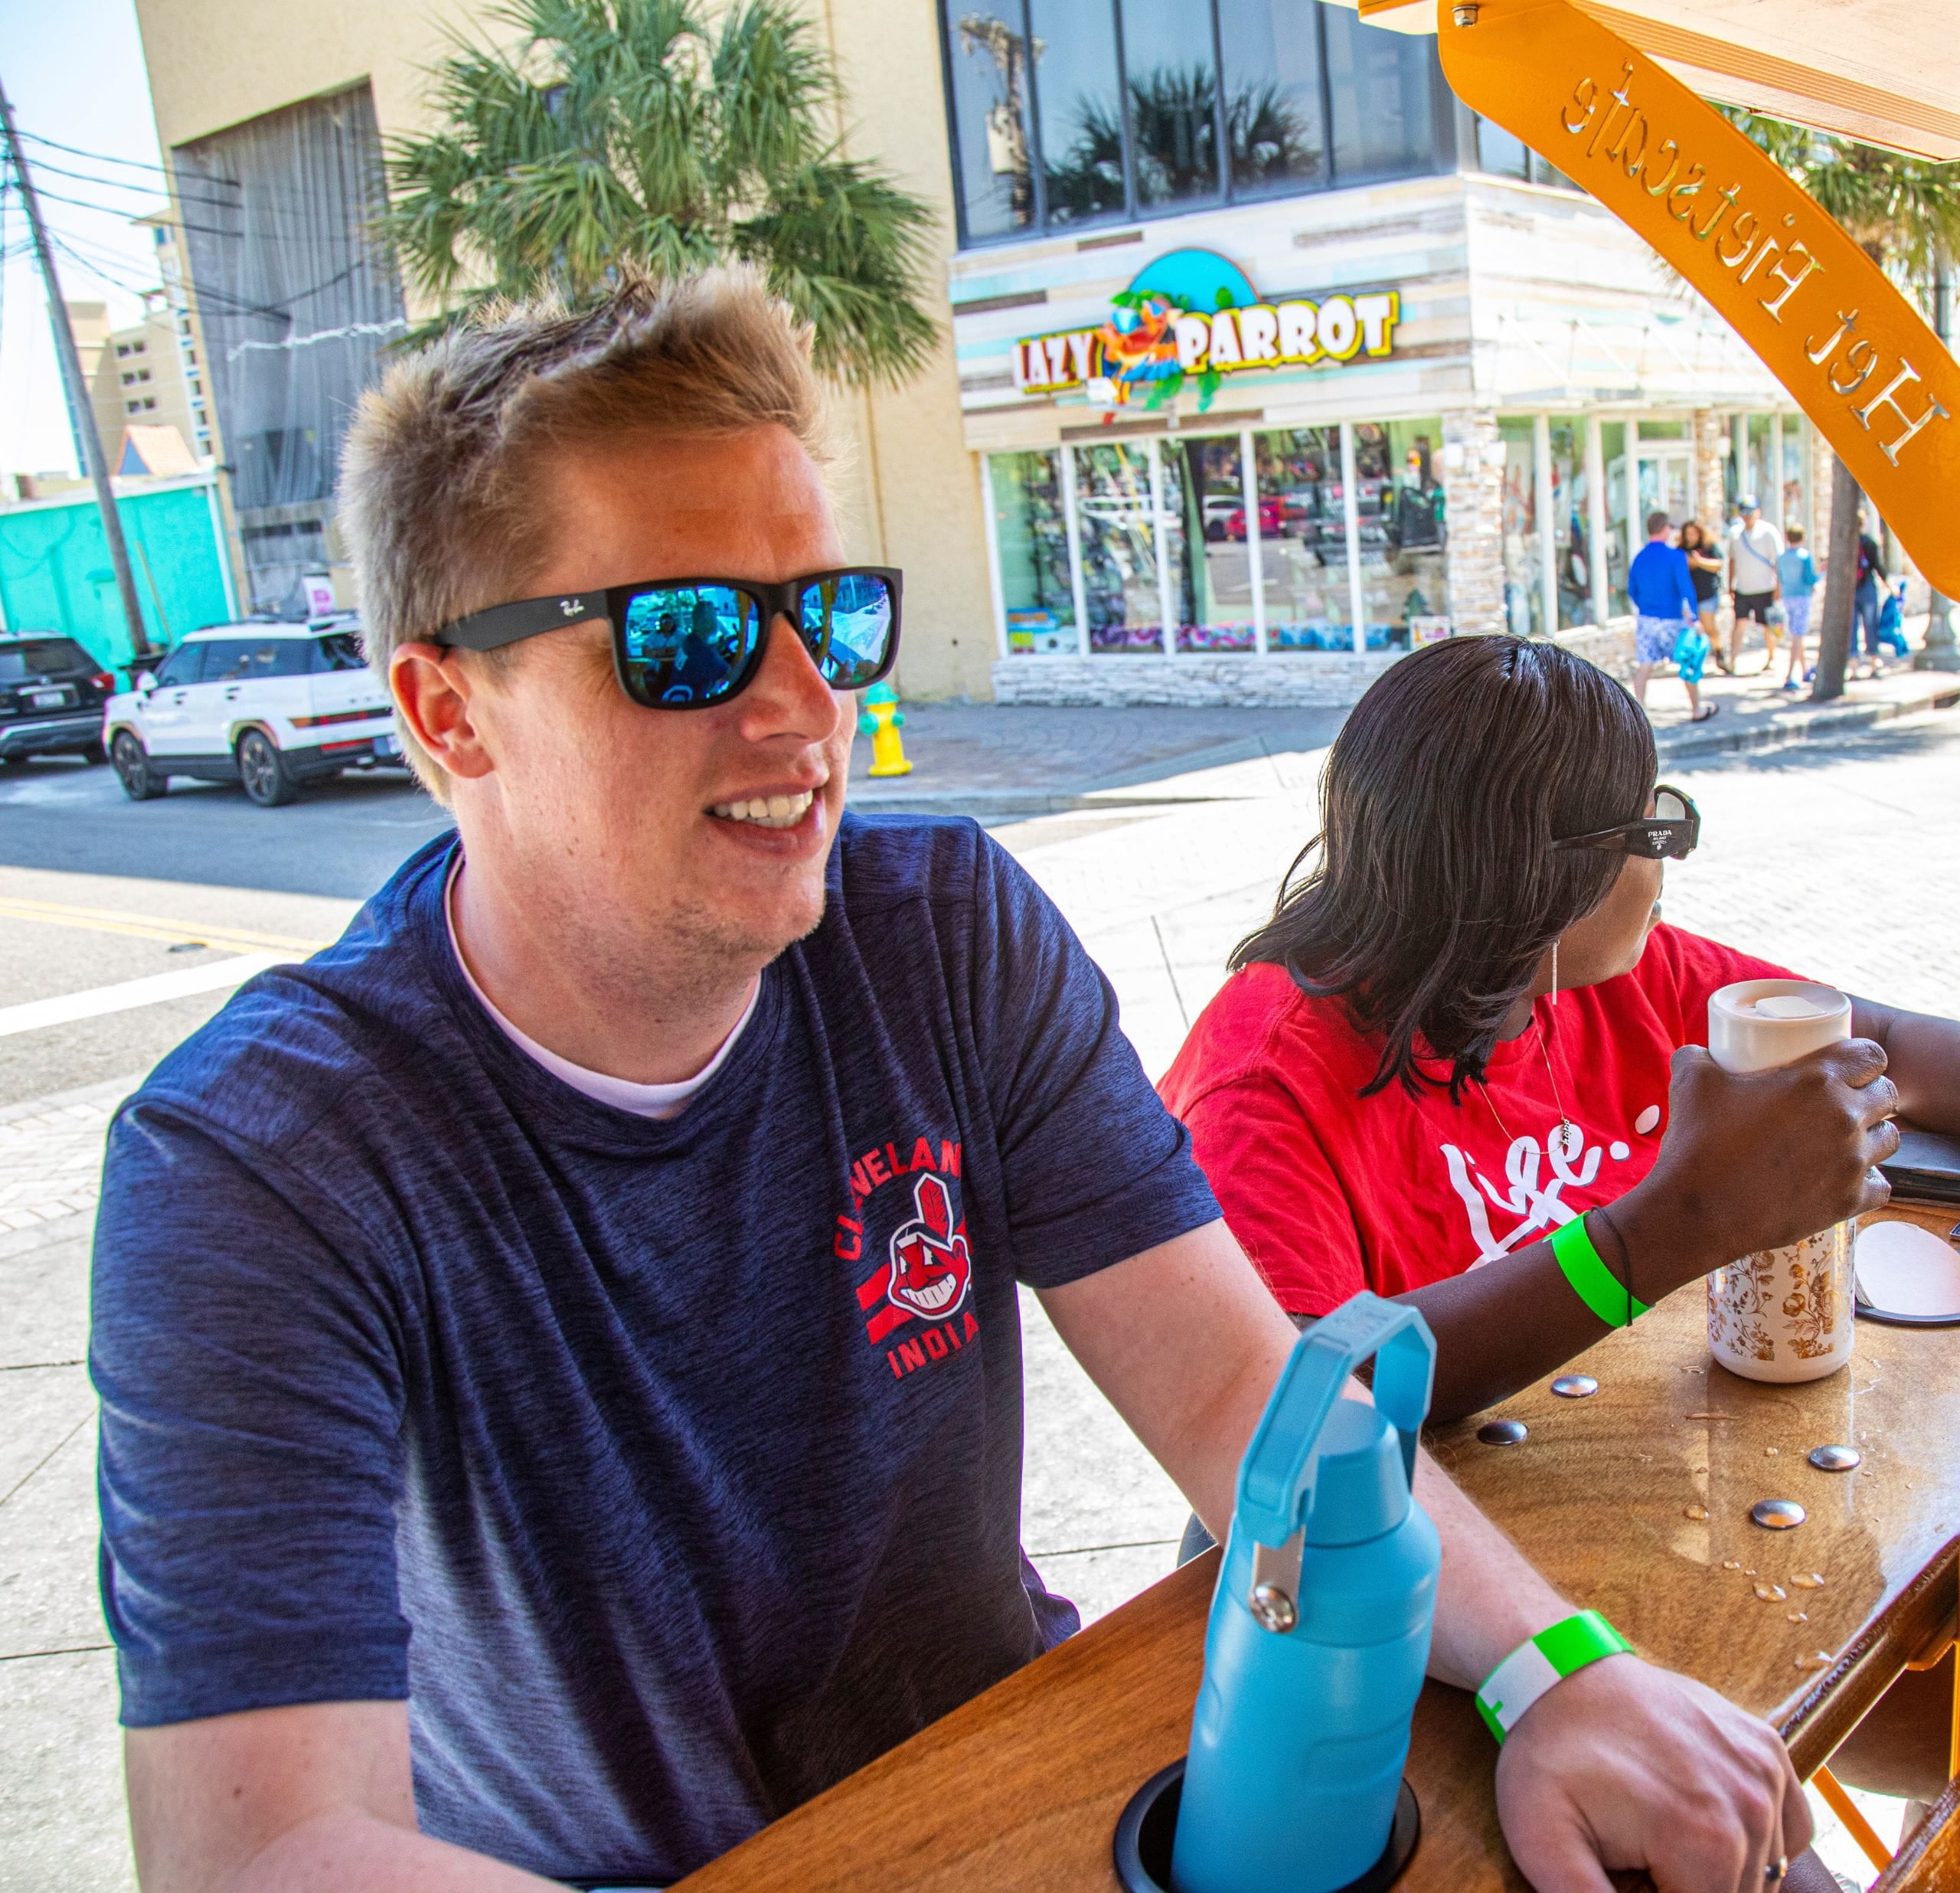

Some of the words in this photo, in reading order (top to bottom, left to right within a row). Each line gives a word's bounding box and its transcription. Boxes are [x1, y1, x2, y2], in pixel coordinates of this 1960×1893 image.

[1012, 329, 1099, 393] LAZY
[1175, 291, 1399, 374] PARROT
[1648, 829, 1672, 838] PRADA
